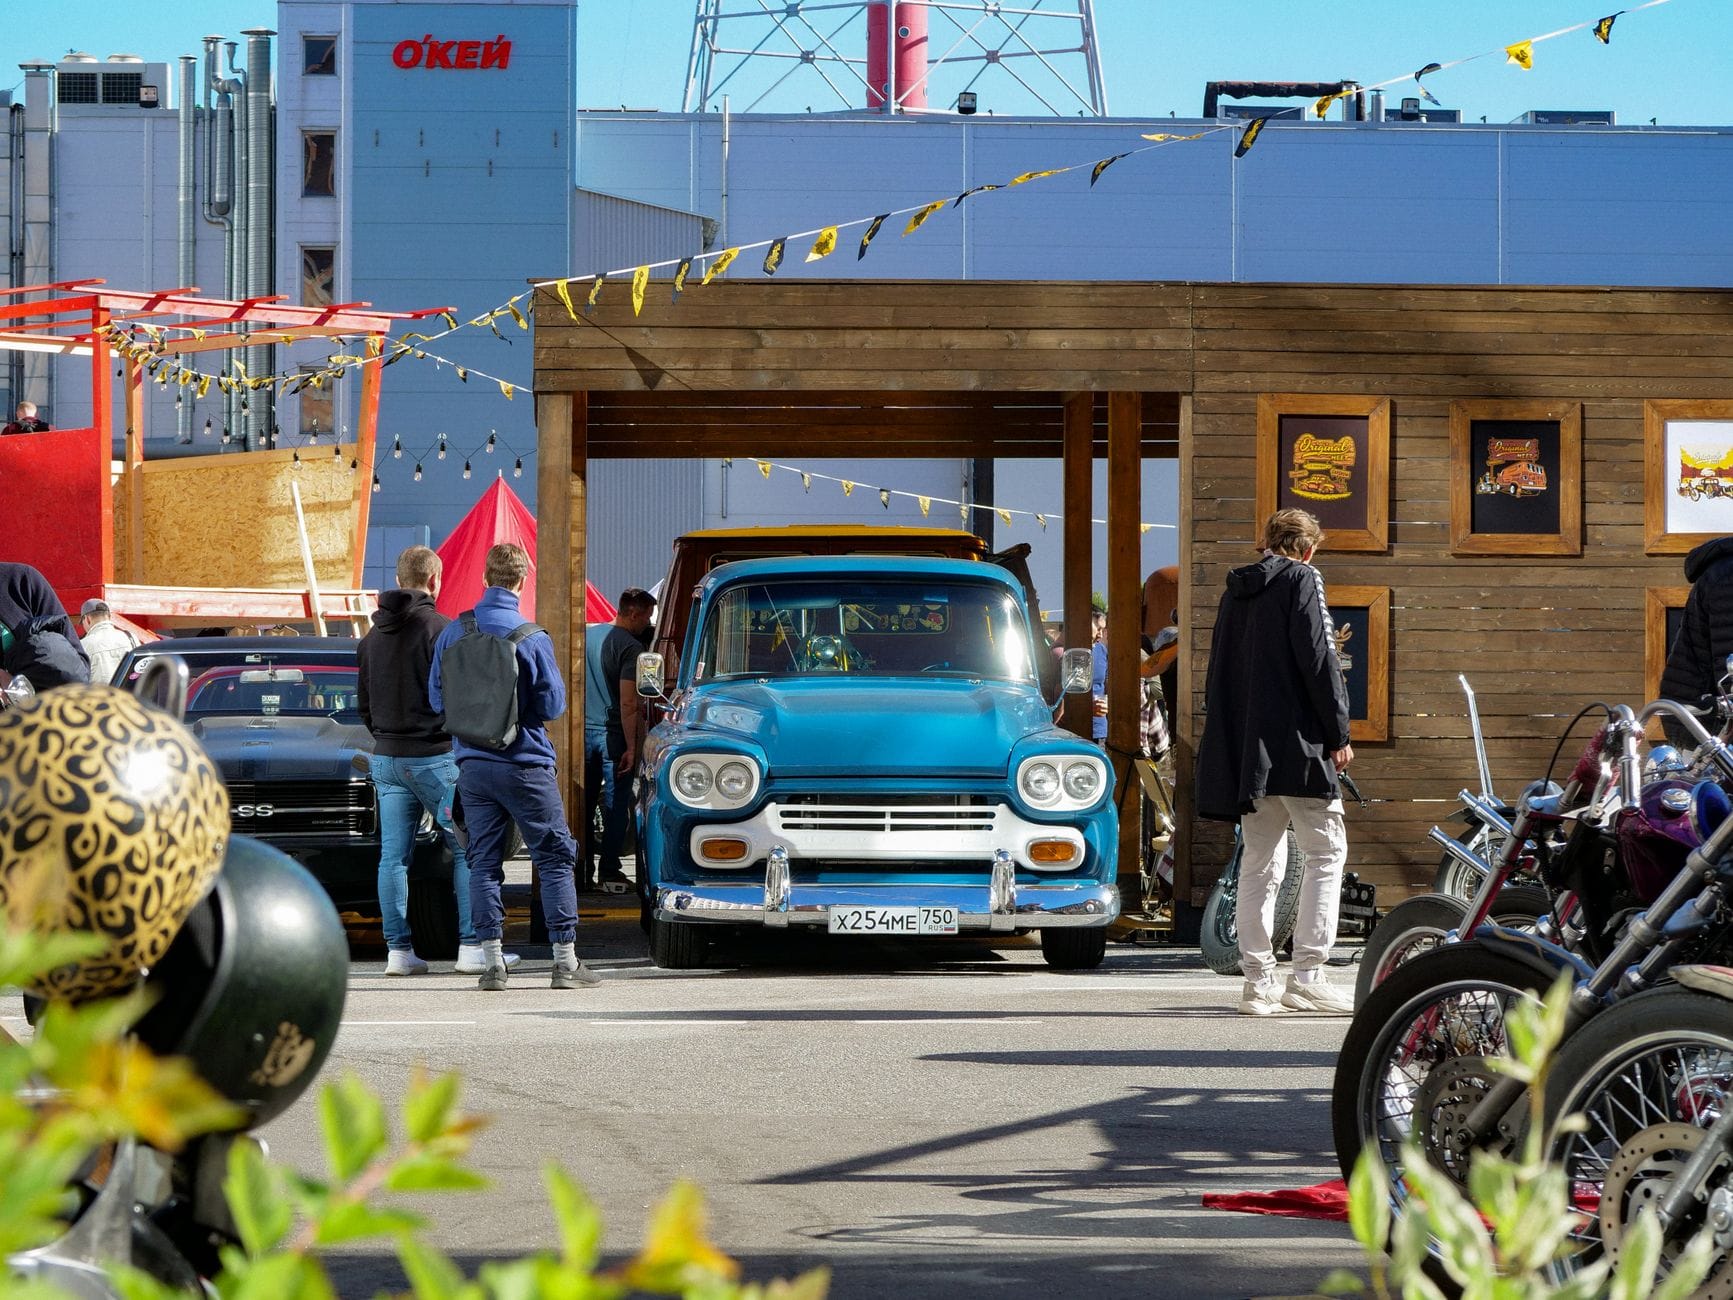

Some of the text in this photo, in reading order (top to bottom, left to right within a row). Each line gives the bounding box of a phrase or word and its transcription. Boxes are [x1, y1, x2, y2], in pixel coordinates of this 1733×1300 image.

[1299, 437, 1349, 453] Original
[1495, 441, 1533, 453] Original
[237, 804, 274, 817] SS
[921, 909, 953, 925] 750
